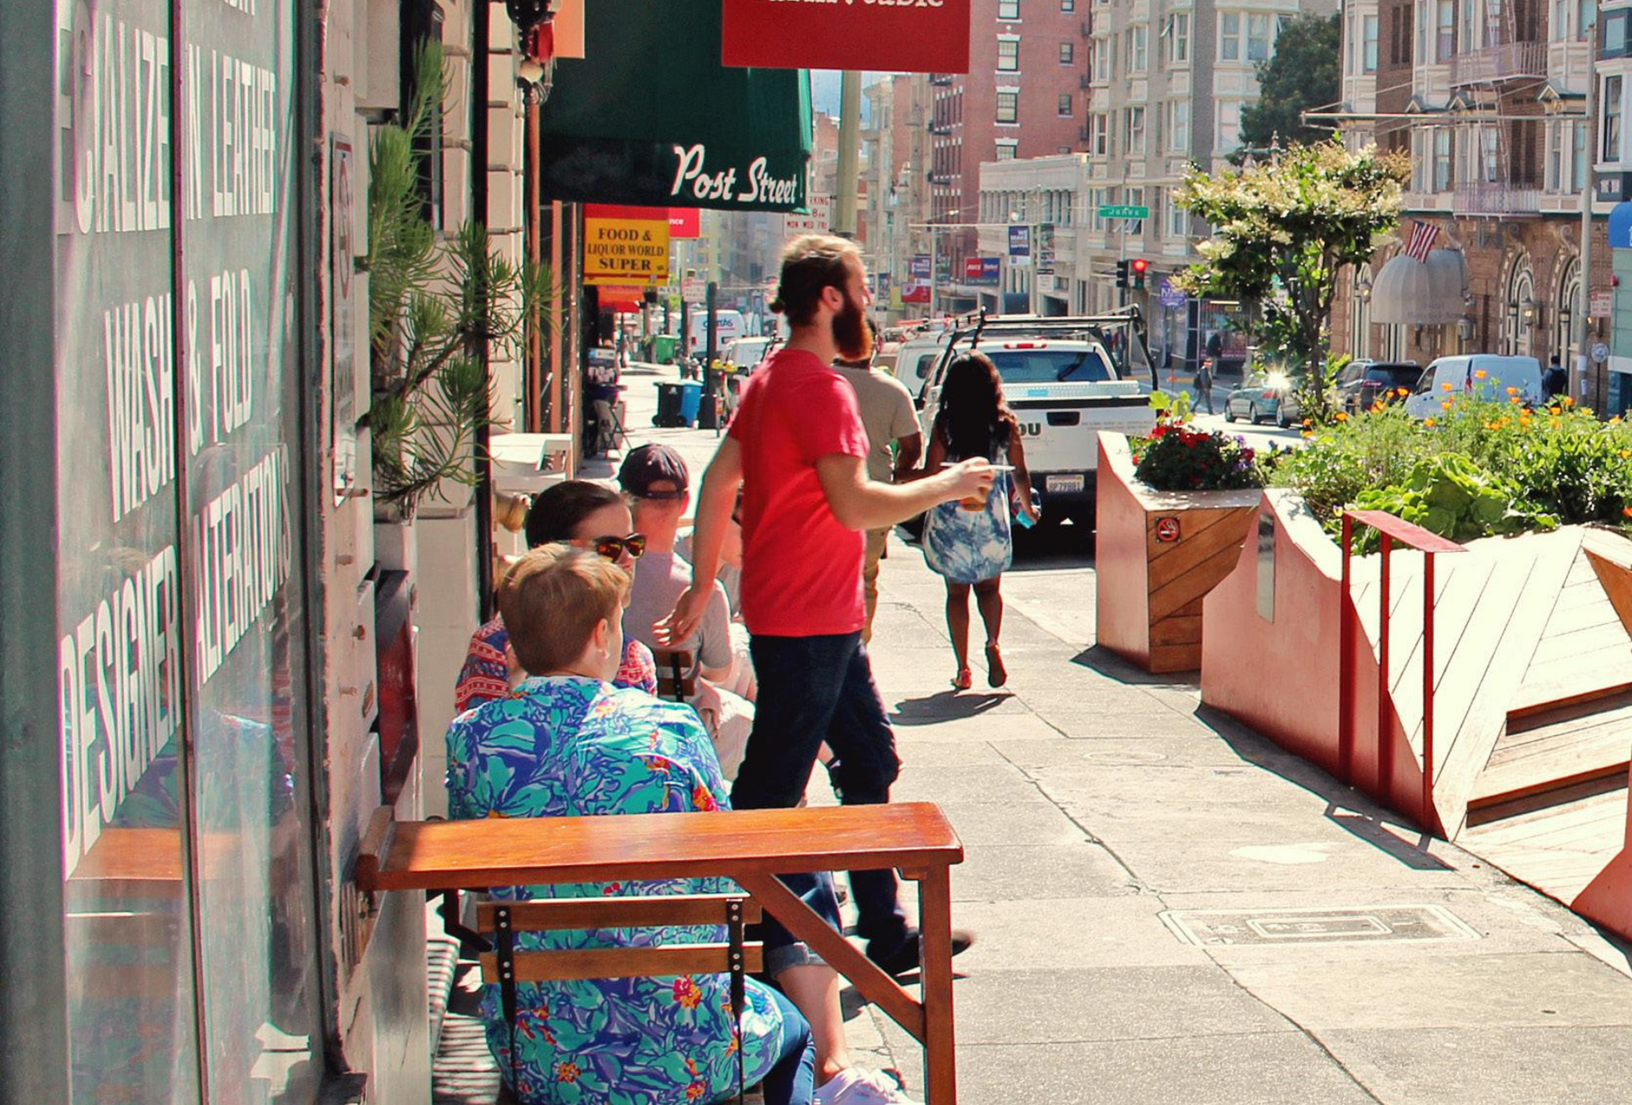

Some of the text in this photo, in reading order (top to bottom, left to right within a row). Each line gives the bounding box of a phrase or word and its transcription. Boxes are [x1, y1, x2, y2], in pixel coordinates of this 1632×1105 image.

[211, 49, 276, 218] LEATHER
[671, 144, 797, 204] Post Street
[1108, 208, 1139, 216] Jones
[587, 243, 664, 256] LIQUOR WORLD
[598, 228, 652, 241] FOOD &
[599, 258, 652, 271] SUPER
[103, 292, 175, 524] WASH
[188, 279, 204, 456] &
[211, 268, 252, 443] FOLD
[59, 443, 292, 881] DESIGNER ALTERATIONS
